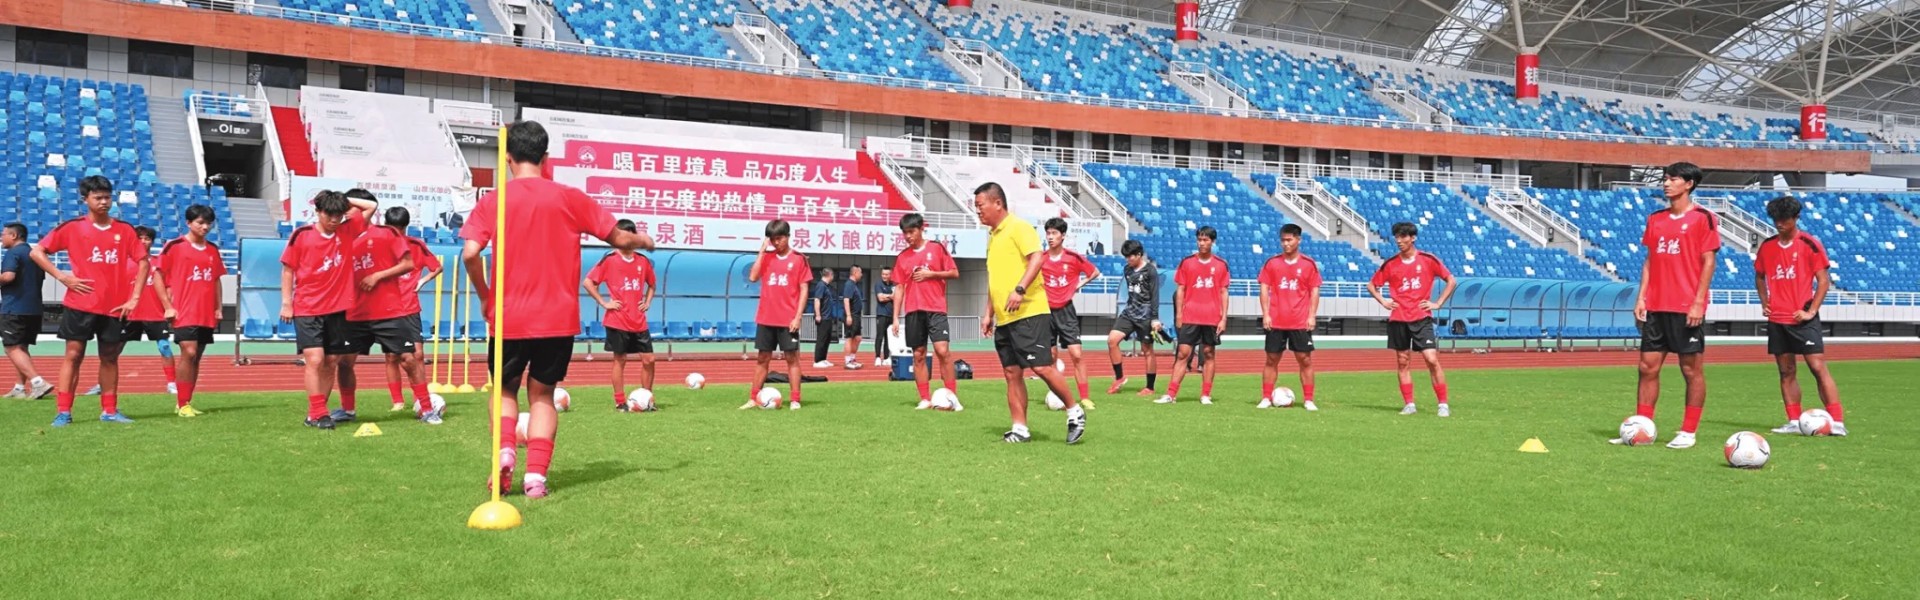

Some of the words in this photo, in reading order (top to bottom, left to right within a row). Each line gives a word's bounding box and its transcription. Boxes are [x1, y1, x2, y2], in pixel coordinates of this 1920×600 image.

[1182, 11, 1198, 31] 业
[1808, 112, 1826, 133] 行
[461, 134, 476, 143] 20
[613, 152, 729, 178] 喝百里境泉
[743, 162, 848, 184] 品75度人生
[626, 186, 766, 214] 用75度的热情
[778, 194, 881, 219] 品百年人生
